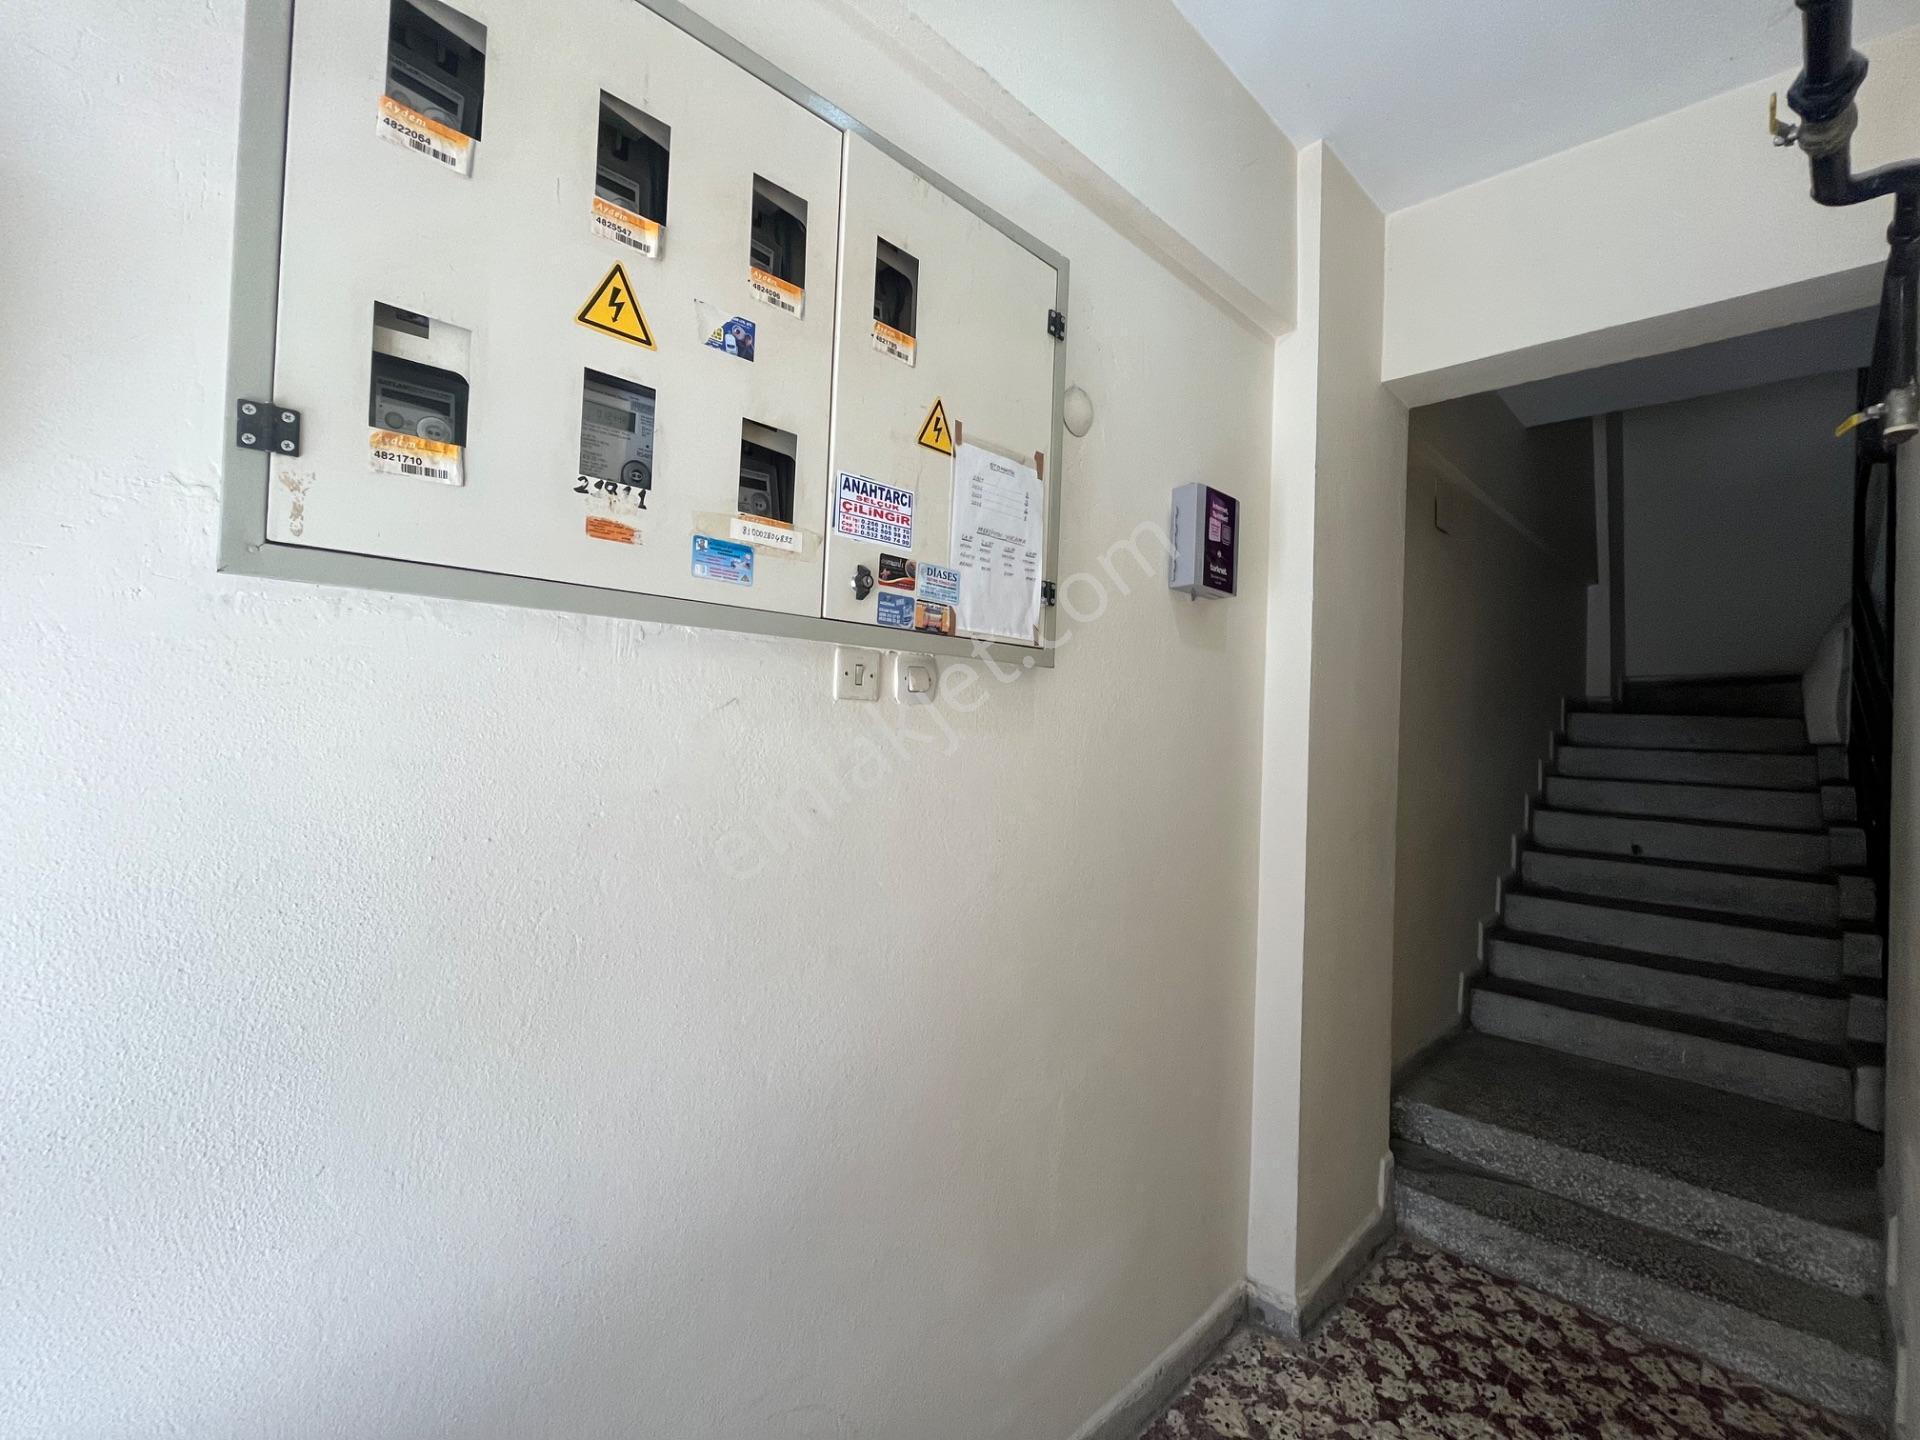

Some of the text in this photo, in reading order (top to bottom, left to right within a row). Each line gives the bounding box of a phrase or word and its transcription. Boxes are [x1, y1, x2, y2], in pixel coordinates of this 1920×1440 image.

[383, 117, 431, 145] 4822064
[374, 450, 422, 465] 4821710
[842, 477, 911, 508] ANAHTARCI
[856, 495, 899, 511] SELÇUK
[926, 567, 958, 582] DİASES
